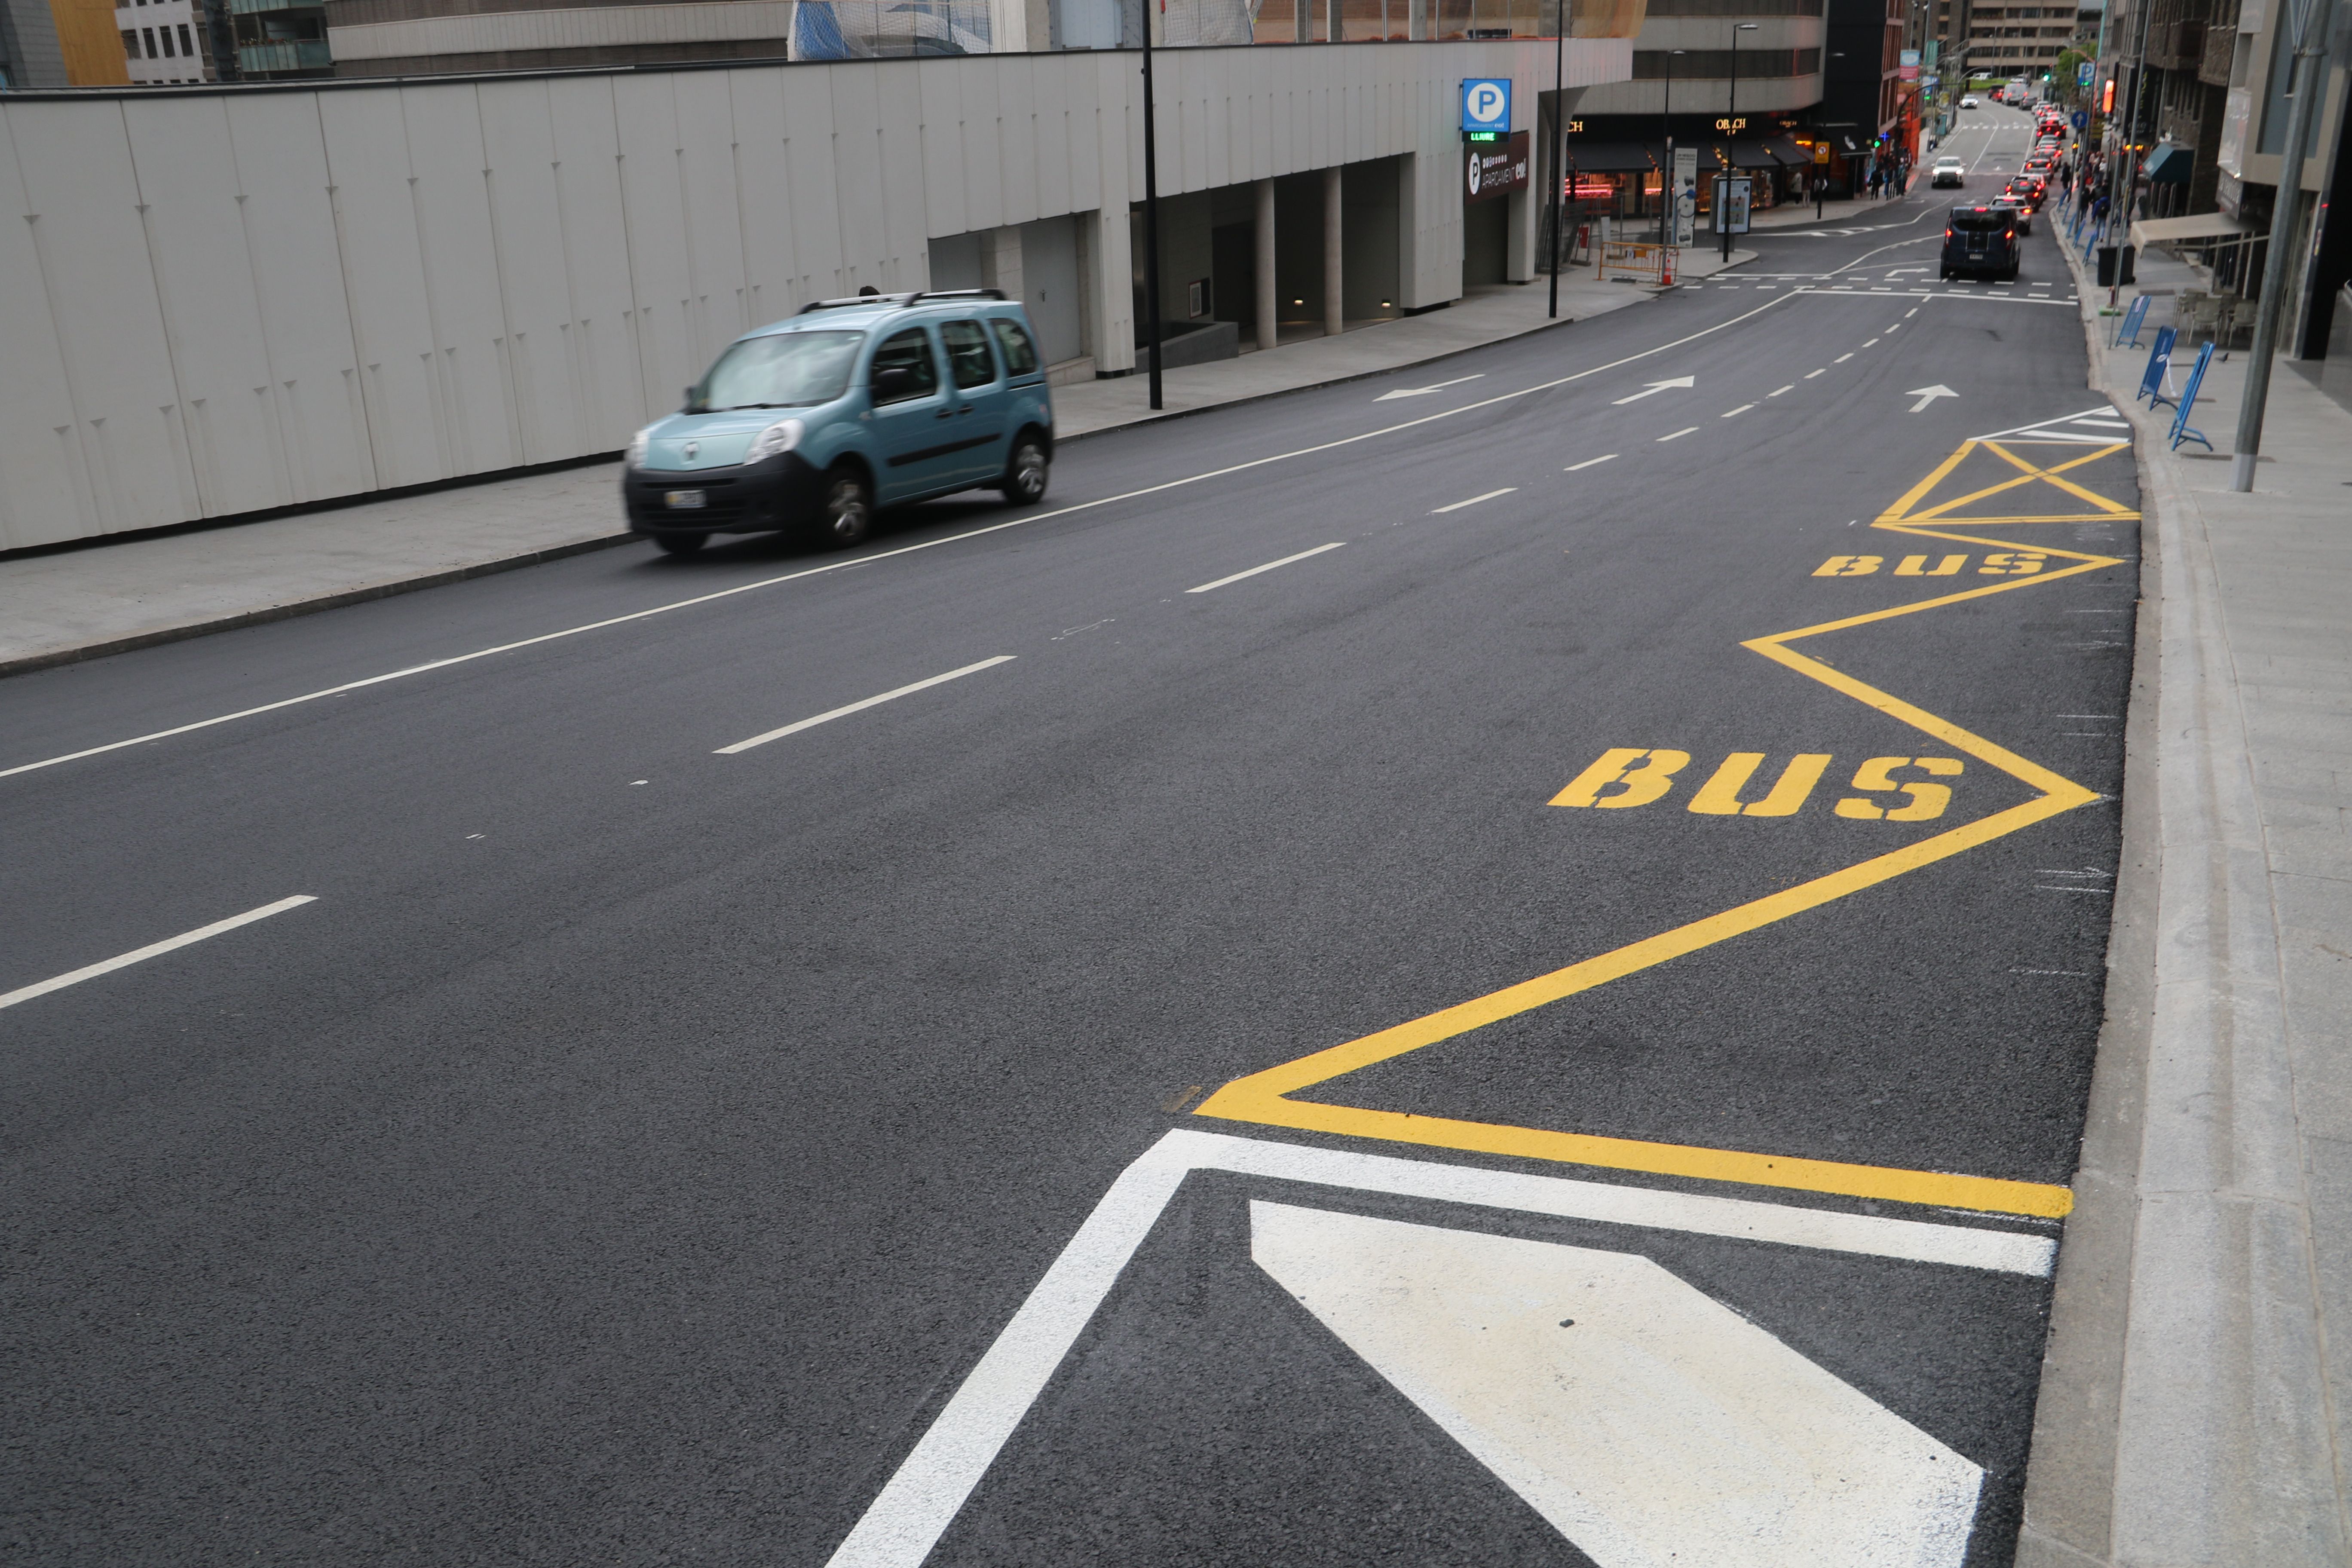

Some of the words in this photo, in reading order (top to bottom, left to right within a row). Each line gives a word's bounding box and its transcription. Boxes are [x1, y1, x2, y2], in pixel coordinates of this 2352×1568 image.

[1479, 90, 1497, 114] P
[1470, 132, 1495, 141] LLIURE
[1473, 162, 1478, 185] P
[1482, 167, 1515, 189] APARCAMENT
[1810, 553, 2047, 576] BUS
[1547, 748, 1964, 821] BUS
